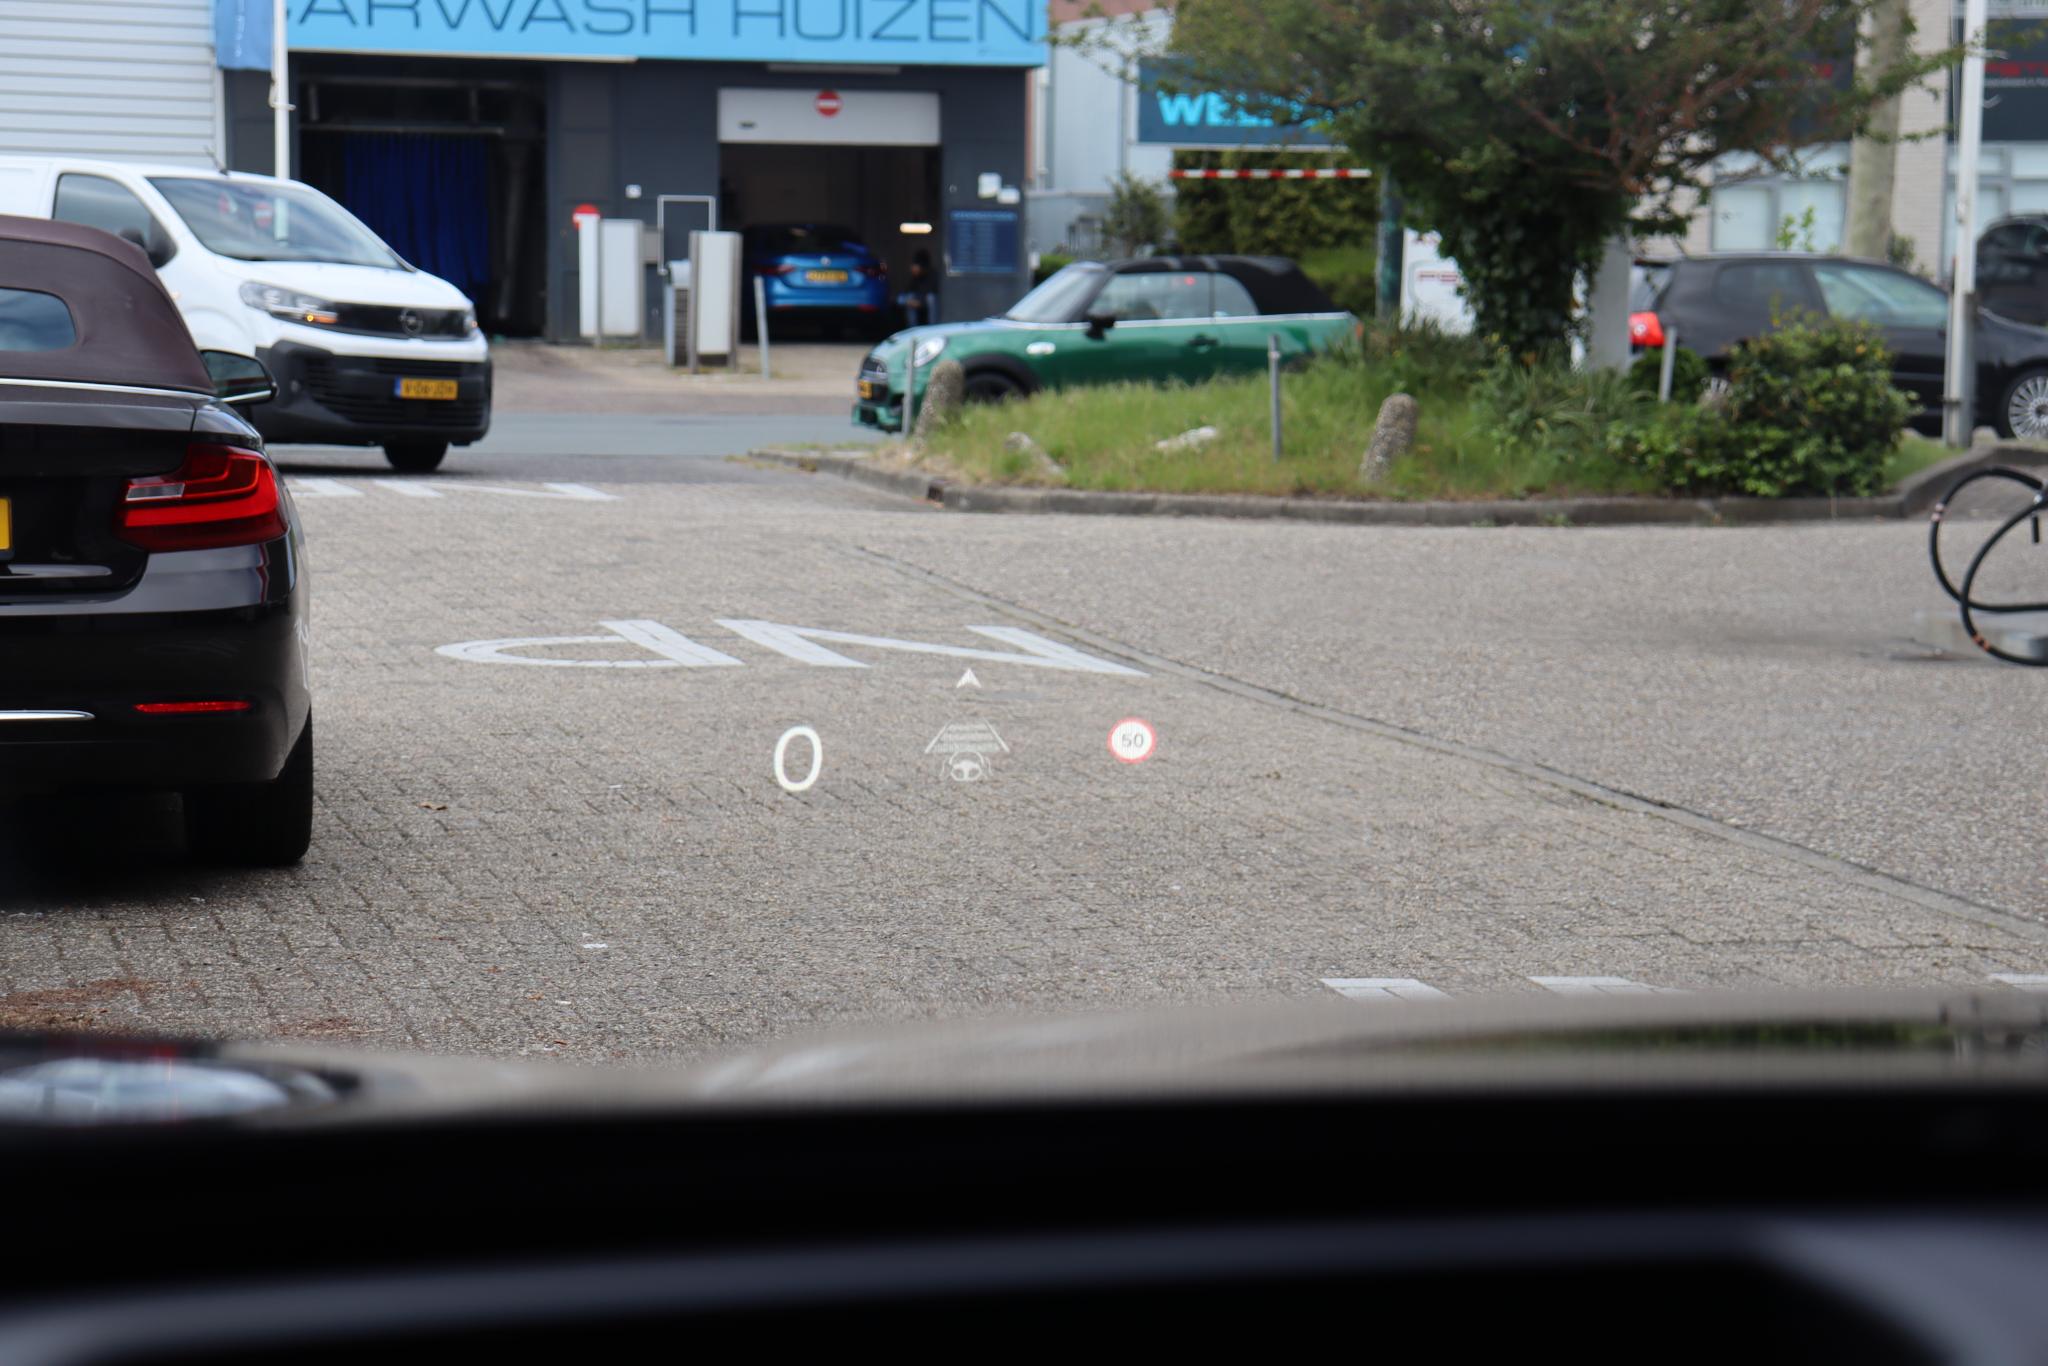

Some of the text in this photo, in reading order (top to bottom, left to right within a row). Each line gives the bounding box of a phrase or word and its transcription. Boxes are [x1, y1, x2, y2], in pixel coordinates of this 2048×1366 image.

[286, 0, 1036, 43] ARWASH HUIZEN
[774, 725, 823, 792] 0
[1122, 733, 1144, 749] 50
